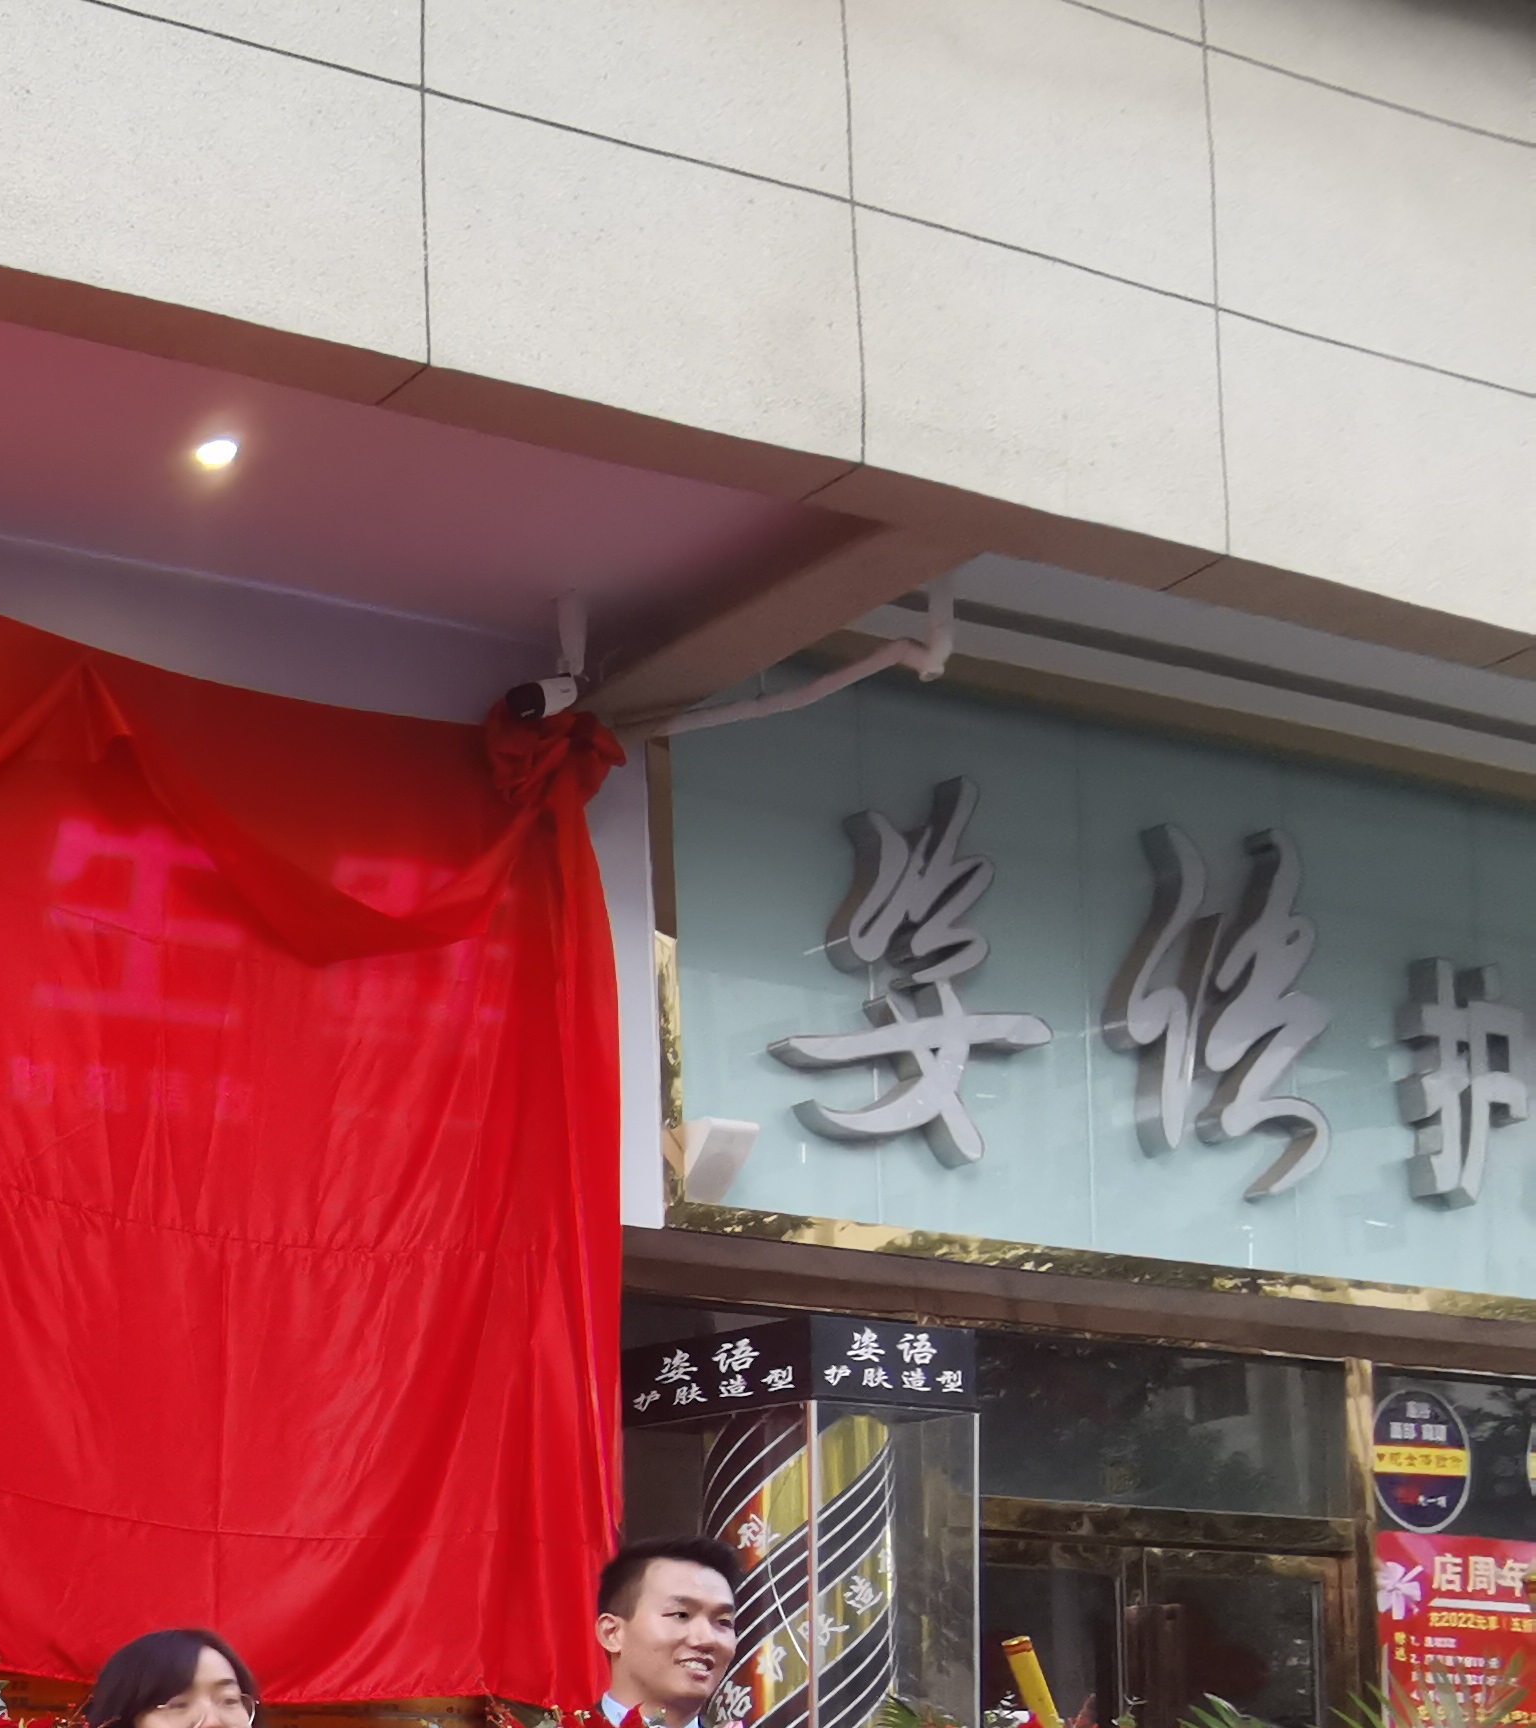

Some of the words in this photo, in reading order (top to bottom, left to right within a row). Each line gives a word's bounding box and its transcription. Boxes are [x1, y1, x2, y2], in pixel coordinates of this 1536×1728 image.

[654, 1337, 761, 1384] 姿语
[845, 1326, 938, 1364] 姿语
[632, 1365, 797, 1413] 护肤造型
[823, 1365, 965, 1394] 护肤造型
